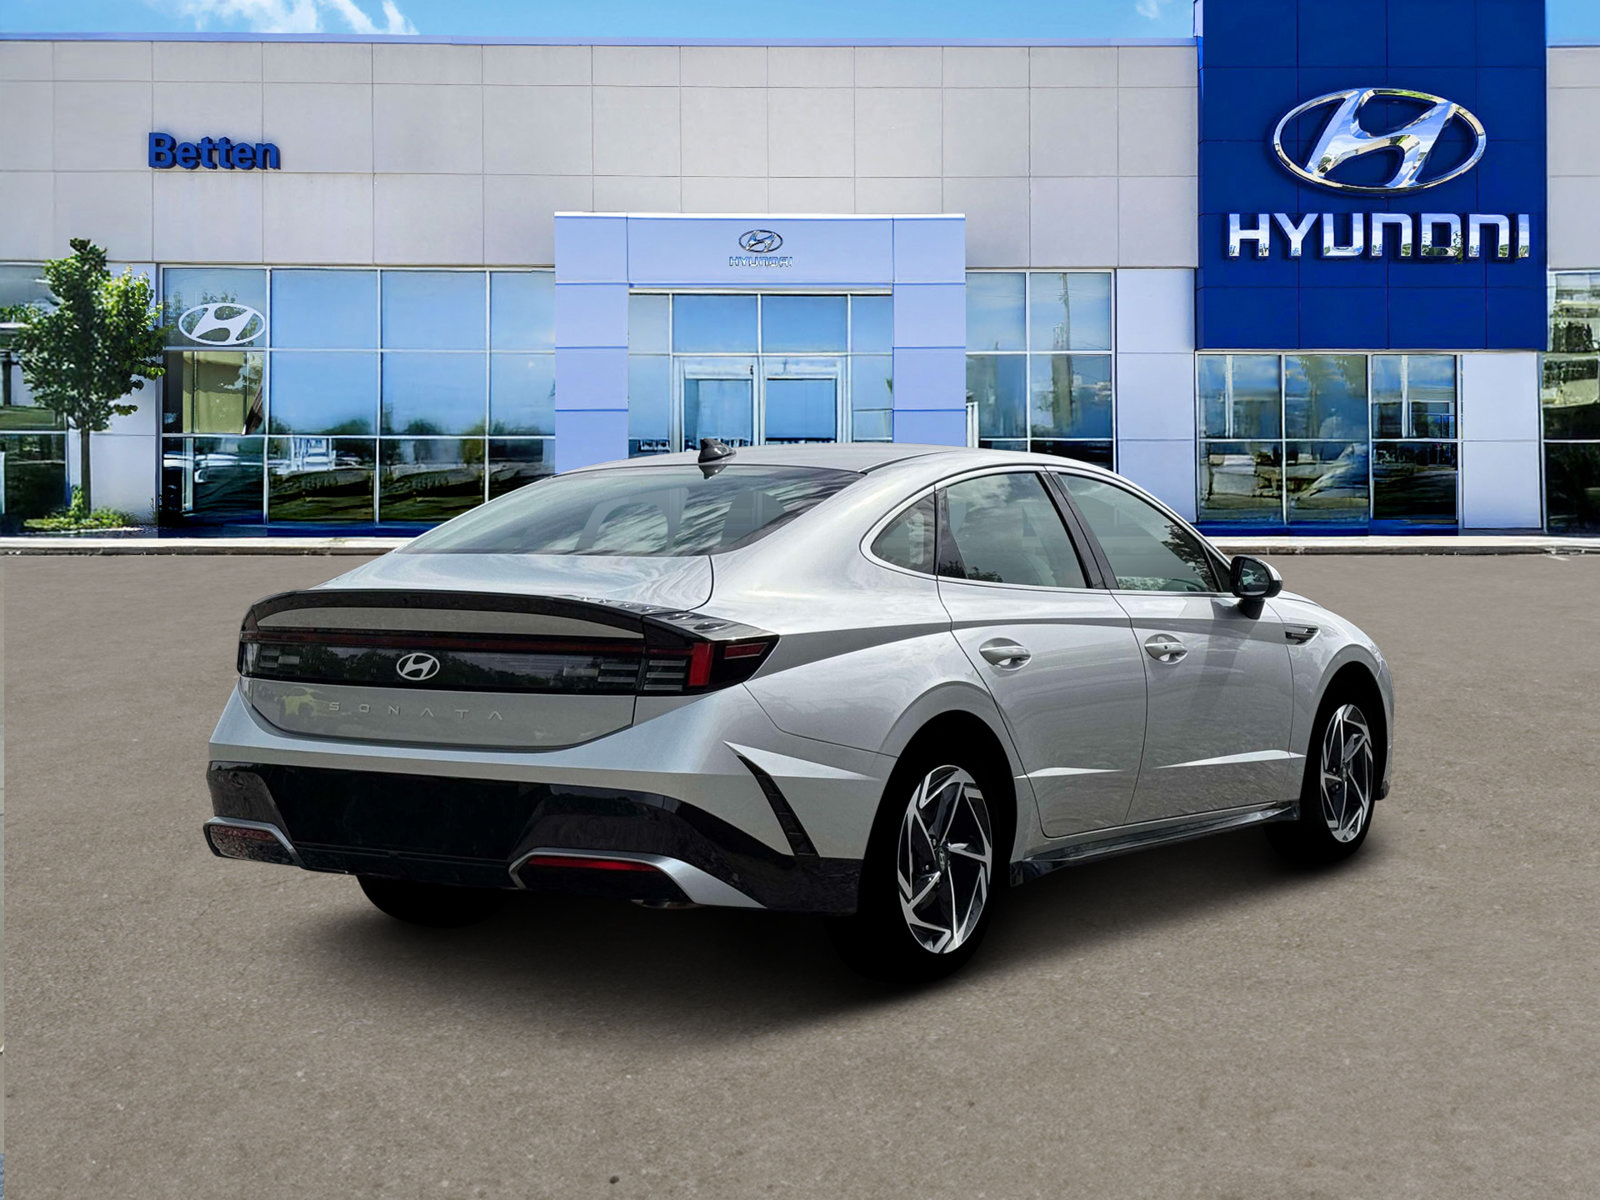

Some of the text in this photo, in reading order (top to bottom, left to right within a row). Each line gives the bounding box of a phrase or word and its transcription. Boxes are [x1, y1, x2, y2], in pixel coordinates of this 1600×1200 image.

[148, 132, 281, 170] Betten
[1228, 213, 1530, 258] HYUNDAI
[729, 256, 793, 267] HYUNDAI
[329, 702, 503, 721] SONATA
